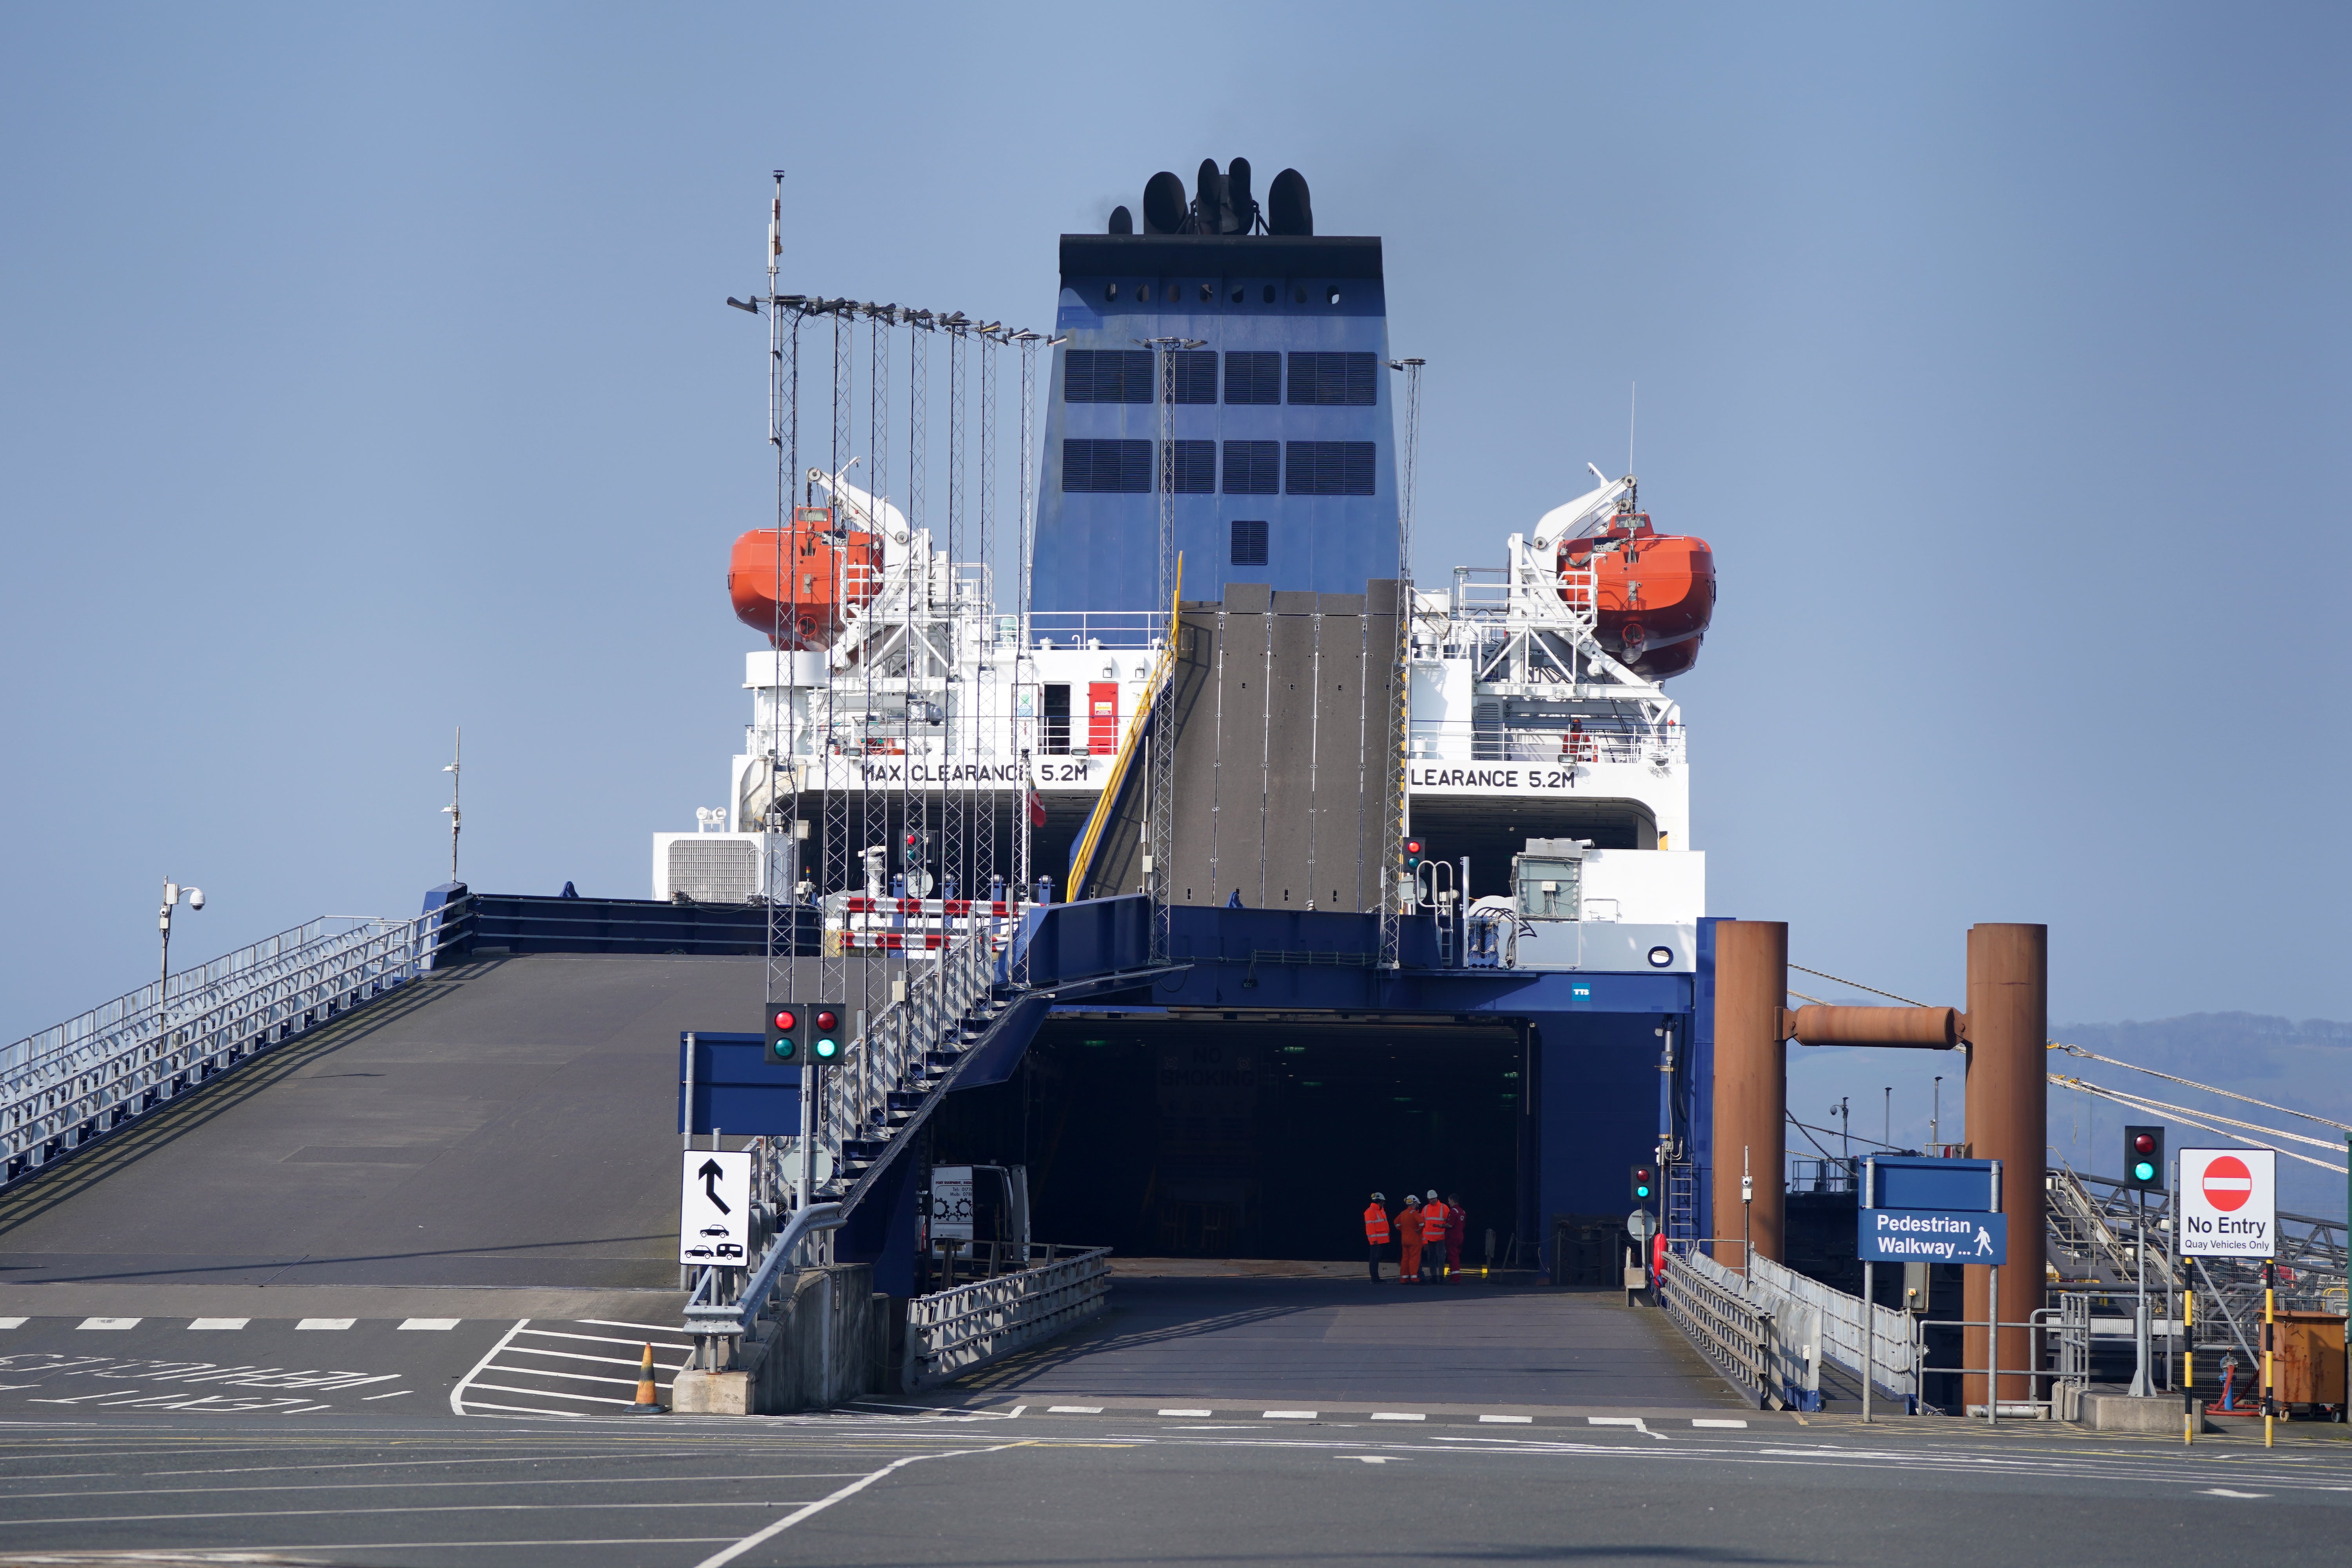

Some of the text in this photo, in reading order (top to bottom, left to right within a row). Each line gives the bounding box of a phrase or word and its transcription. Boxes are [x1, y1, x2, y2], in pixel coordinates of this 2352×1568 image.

[1042, 764, 1088, 781] 5.2M
[1411, 769, 1575, 788] LEARANCE 5.2M
[1192, 1047, 1222, 1064] NO
[1160, 1069, 1255, 1087] SMOKING
[1877, 1214, 1970, 1233] Pedestrian
[2188, 1216, 2266, 1238] No Entry
[1878, 1237, 1955, 1259] Walkway
[2185, 1240, 2269, 1251] Quay Vehicles Only
